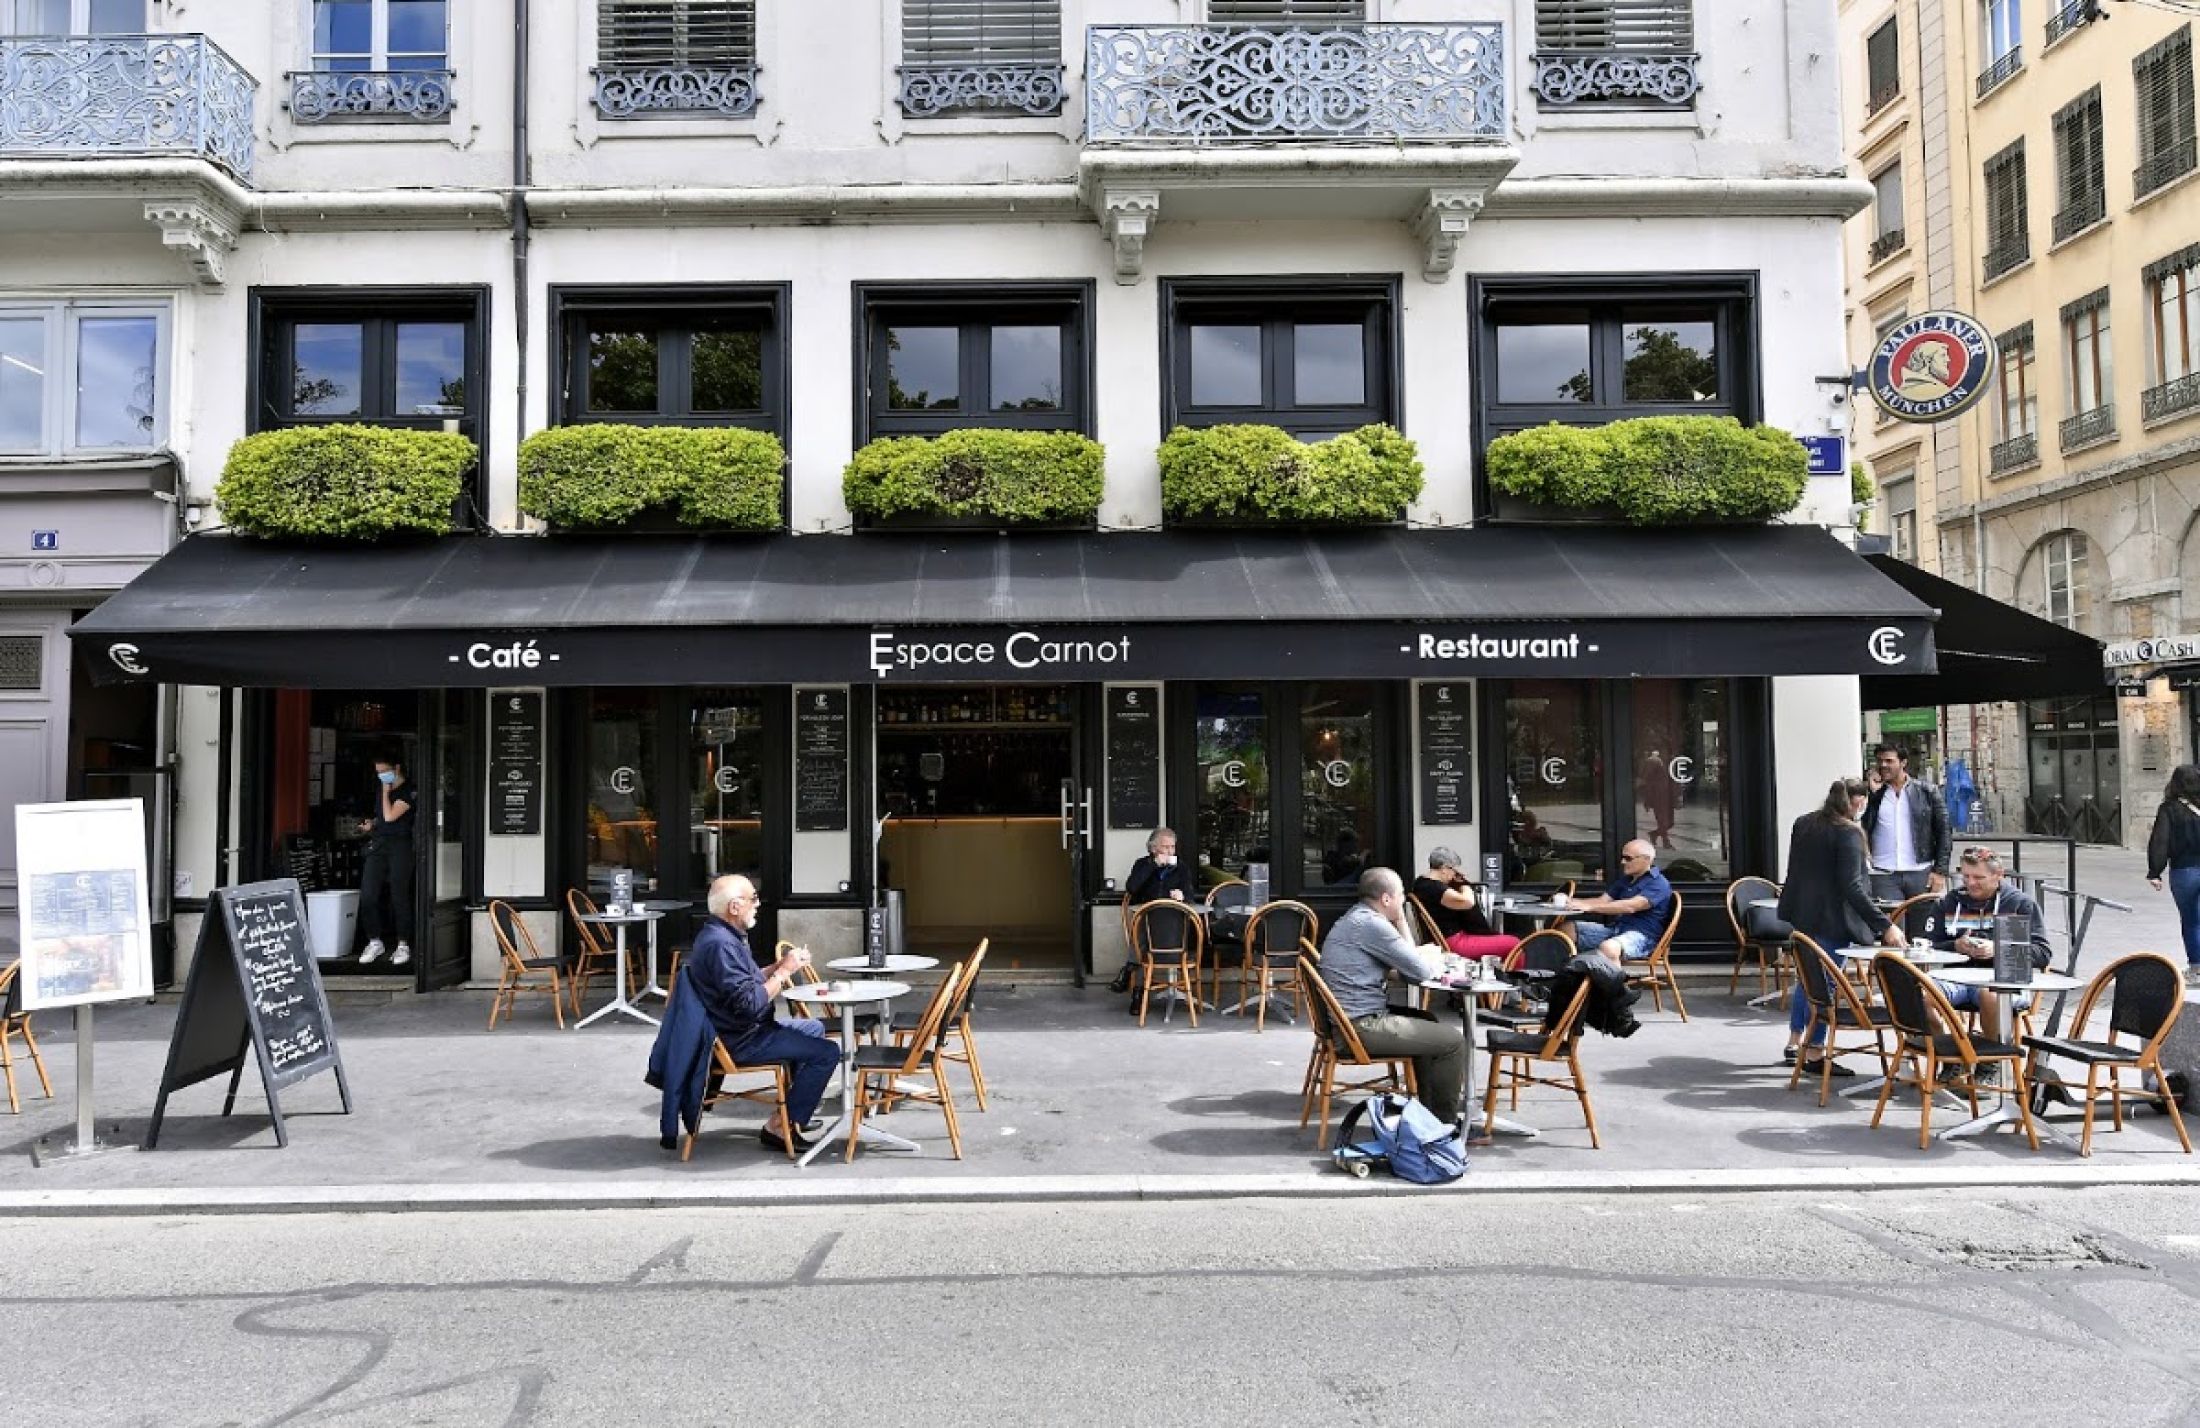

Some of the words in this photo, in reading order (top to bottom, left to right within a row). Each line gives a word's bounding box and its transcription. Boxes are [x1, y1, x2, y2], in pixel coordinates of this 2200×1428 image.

[1878, 316, 1985, 359] PAULANER
[40, 535, 49, 547] 4
[467, 639, 542, 668] Café
[870, 633, 995, 679] Espace
[1005, 631, 1131, 668] Carnot
[1418, 633, 1580, 659] Restaurant
[2104, 648, 2134, 663] OBAL
